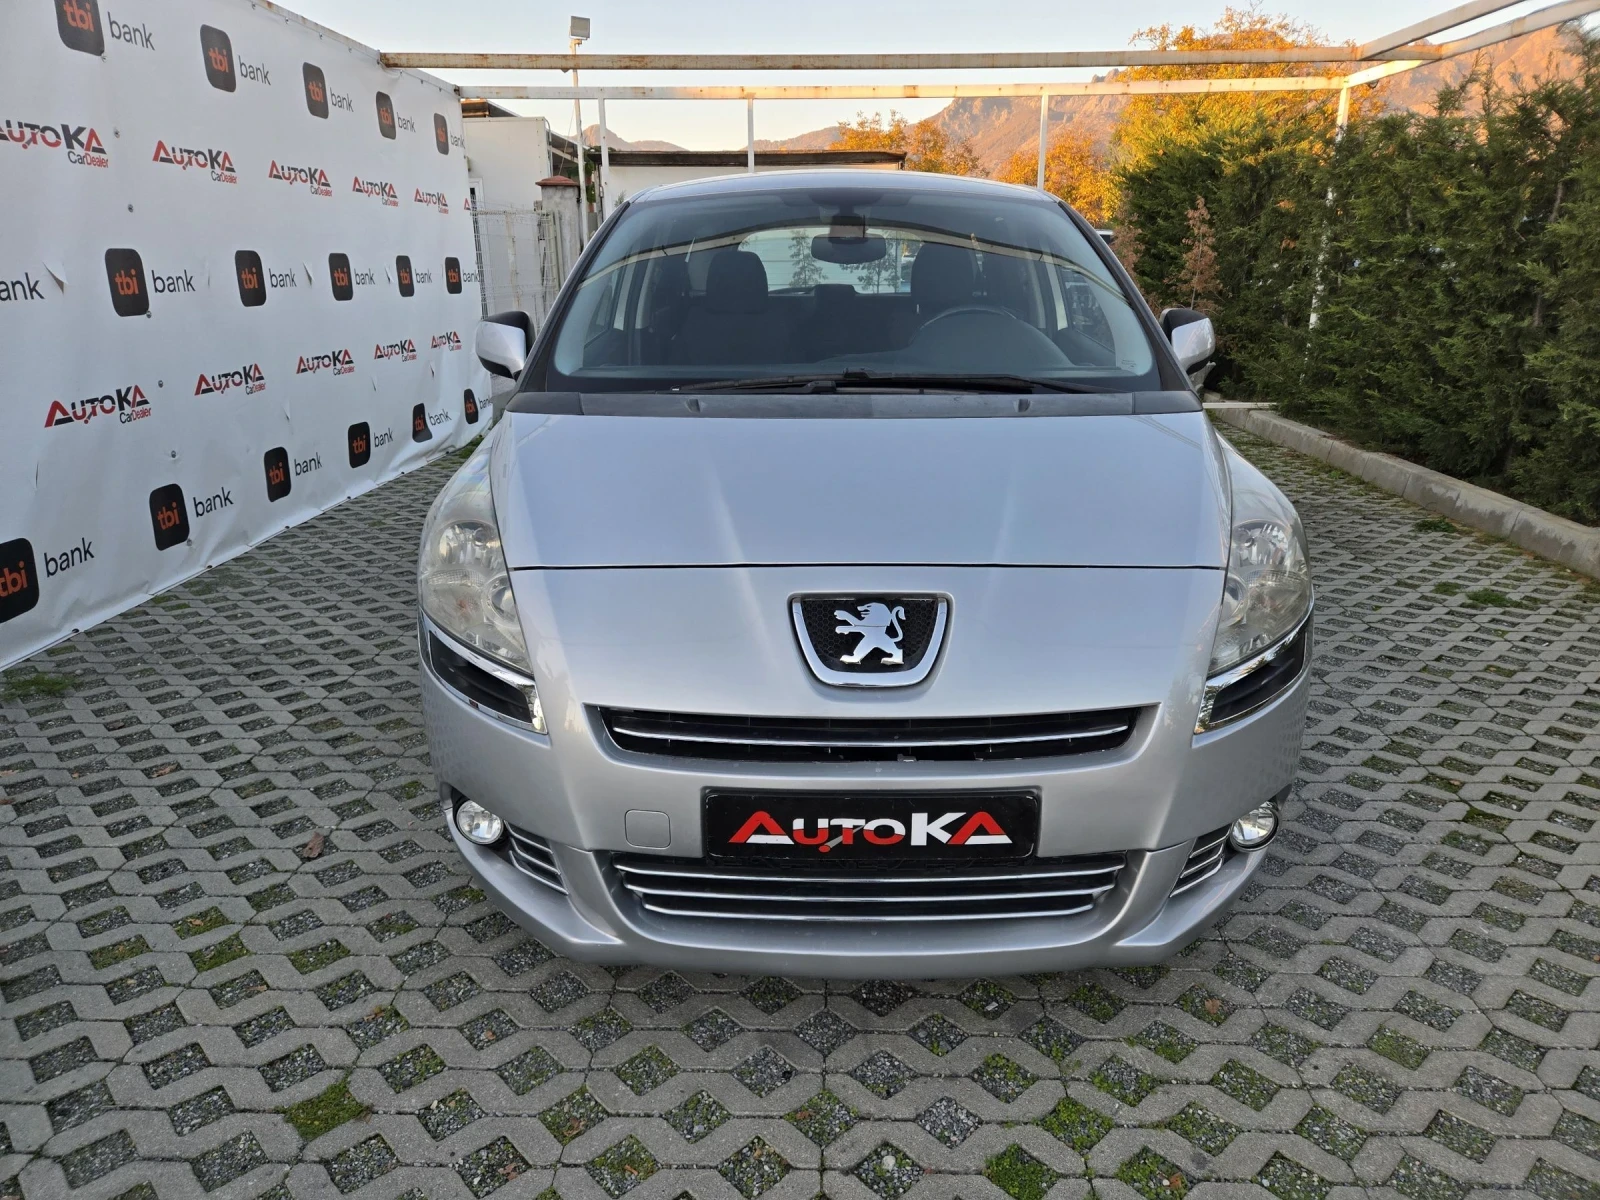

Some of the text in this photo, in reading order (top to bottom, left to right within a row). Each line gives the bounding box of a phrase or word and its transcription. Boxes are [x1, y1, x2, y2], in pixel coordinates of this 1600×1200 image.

[63, 0, 155, 51] tbi bank
[208, 47, 271, 85] tbi bank
[308, 81, 354, 112] tbi bank
[397, 112, 416, 133] bank
[67, 150, 108, 169] CarDealer
[152, 140, 236, 173] AUTOKA
[268, 160, 331, 188] AUTOKA
[352, 176, 398, 199] AUTOKA
[0, 272, 45, 301] ank
[114, 268, 196, 296] tbi bank
[241, 267, 298, 290] tbi bank
[334, 267, 376, 286] tbi bank
[415, 269, 432, 284] bank
[296, 349, 354, 374] AUTOKA
[374, 339, 417, 361] AUTOKA
[194, 363, 265, 395] AUTOKA
[44, 384, 150, 428] AUTOKA
[119, 406, 152, 424] CarDealer
[414, 409, 451, 432] tbi bank
[352, 427, 394, 455] tbi bank
[269, 451, 323, 486] tbi bank
[157, 486, 234, 531] tbi bank
[43, 537, 95, 578] bank
[728, 811, 1013, 854] AUTOKA
